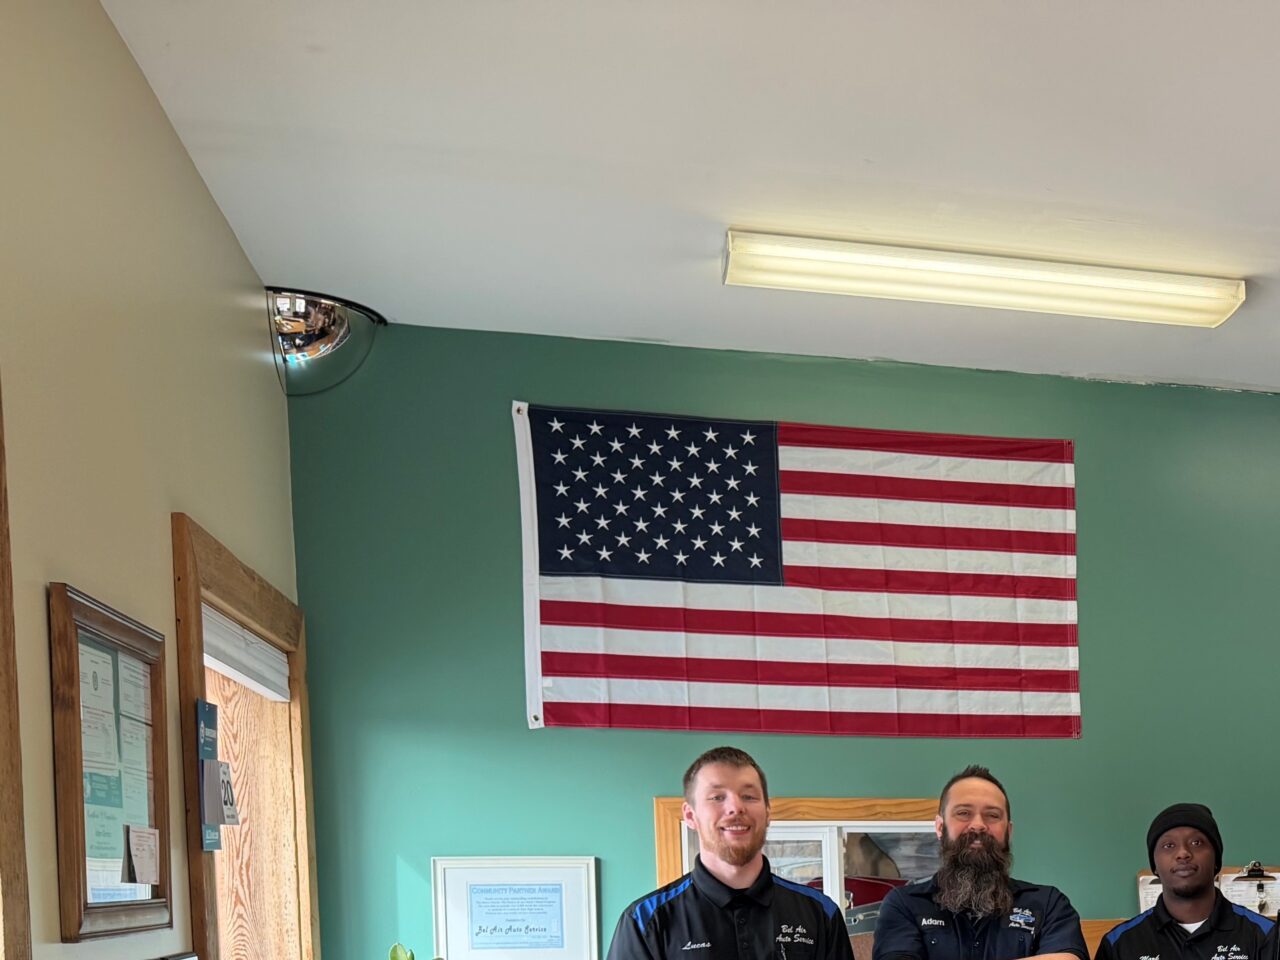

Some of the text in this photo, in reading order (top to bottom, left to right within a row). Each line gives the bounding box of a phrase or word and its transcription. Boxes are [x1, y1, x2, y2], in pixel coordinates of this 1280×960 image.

[222, 780, 234, 807] 20
[921, 917, 945, 926] Adam
[781, 925, 807, 933] Bel Air
[776, 934, 814, 945] Auto Service
[682, 941, 711, 950] Lucas
[1230, 944, 1240, 952] Air
[1227, 952, 1249, 960] Service
